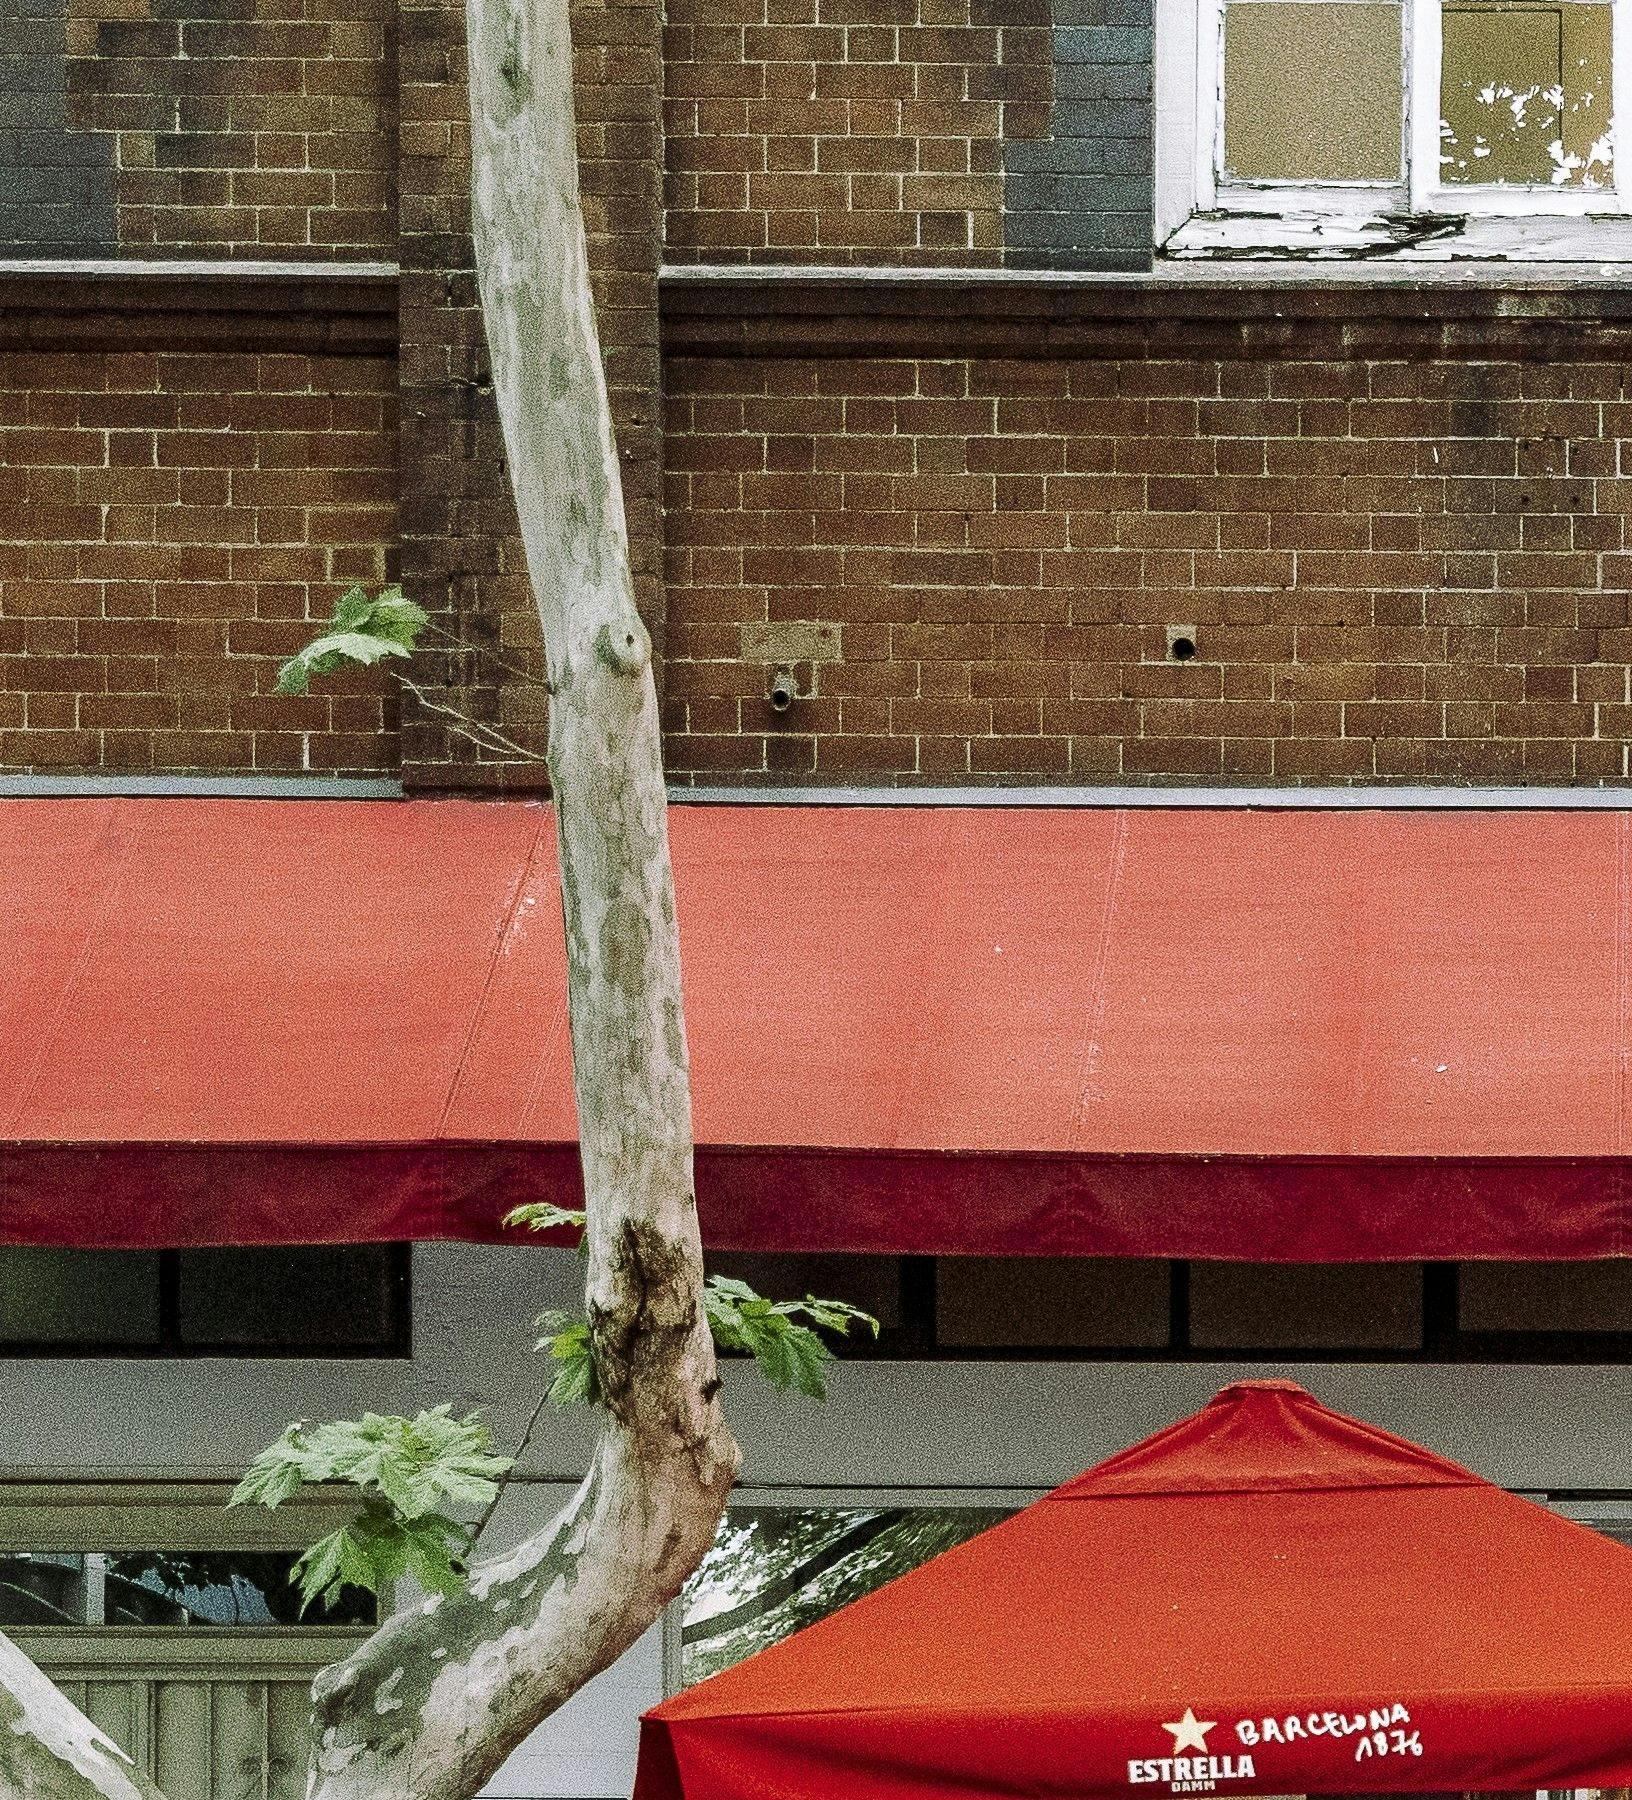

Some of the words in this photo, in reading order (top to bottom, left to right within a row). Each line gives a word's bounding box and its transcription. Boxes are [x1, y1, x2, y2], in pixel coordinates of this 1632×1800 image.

[1236, 1703, 1410, 1746] BARCELONA
[1355, 1730, 1424, 1762] 1876
[1127, 1754, 1256, 1784] ESTRELLA
[1171, 1779, 1216, 1793] DAMM
